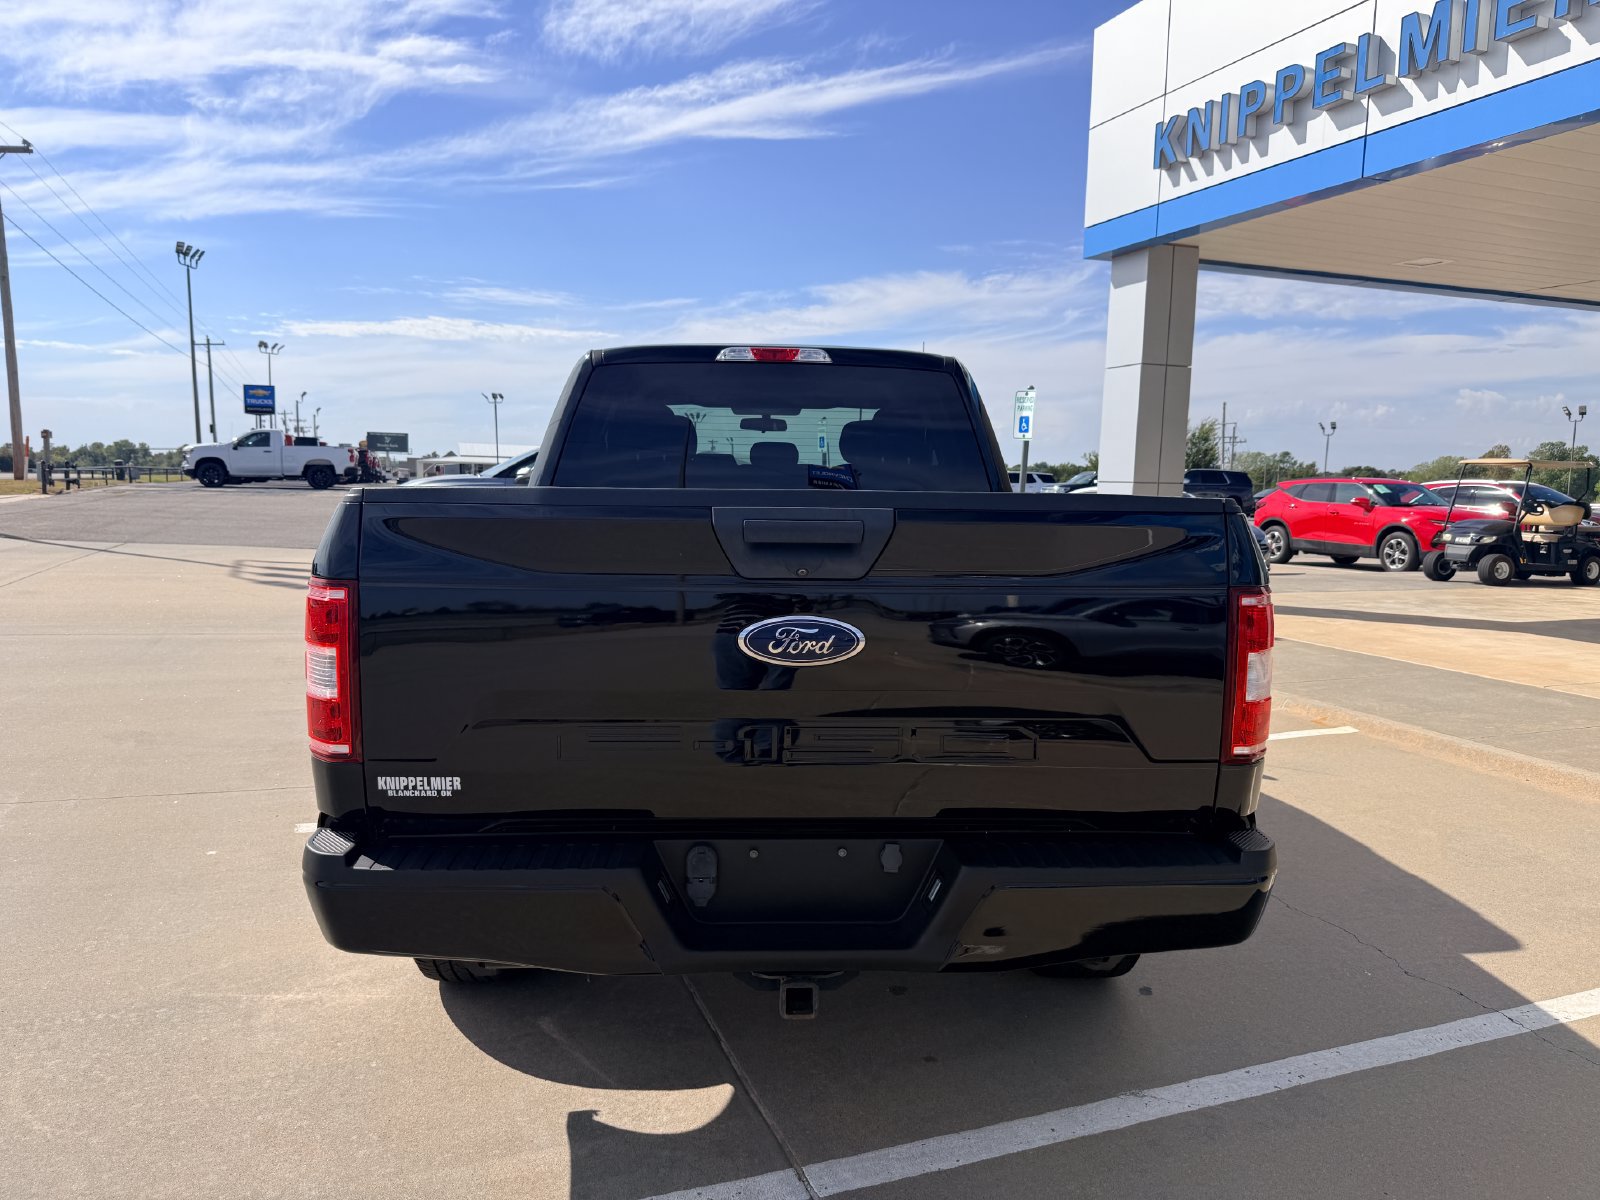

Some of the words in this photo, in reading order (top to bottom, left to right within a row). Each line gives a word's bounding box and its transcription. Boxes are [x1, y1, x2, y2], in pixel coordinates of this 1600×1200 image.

[1153, 0, 1600, 170] KNIPPELMIE
[768, 626, 835, 654] Ford
[377, 776, 461, 790] KNIPPELMIER
[388, 790, 439, 798] BLANCHARD,
